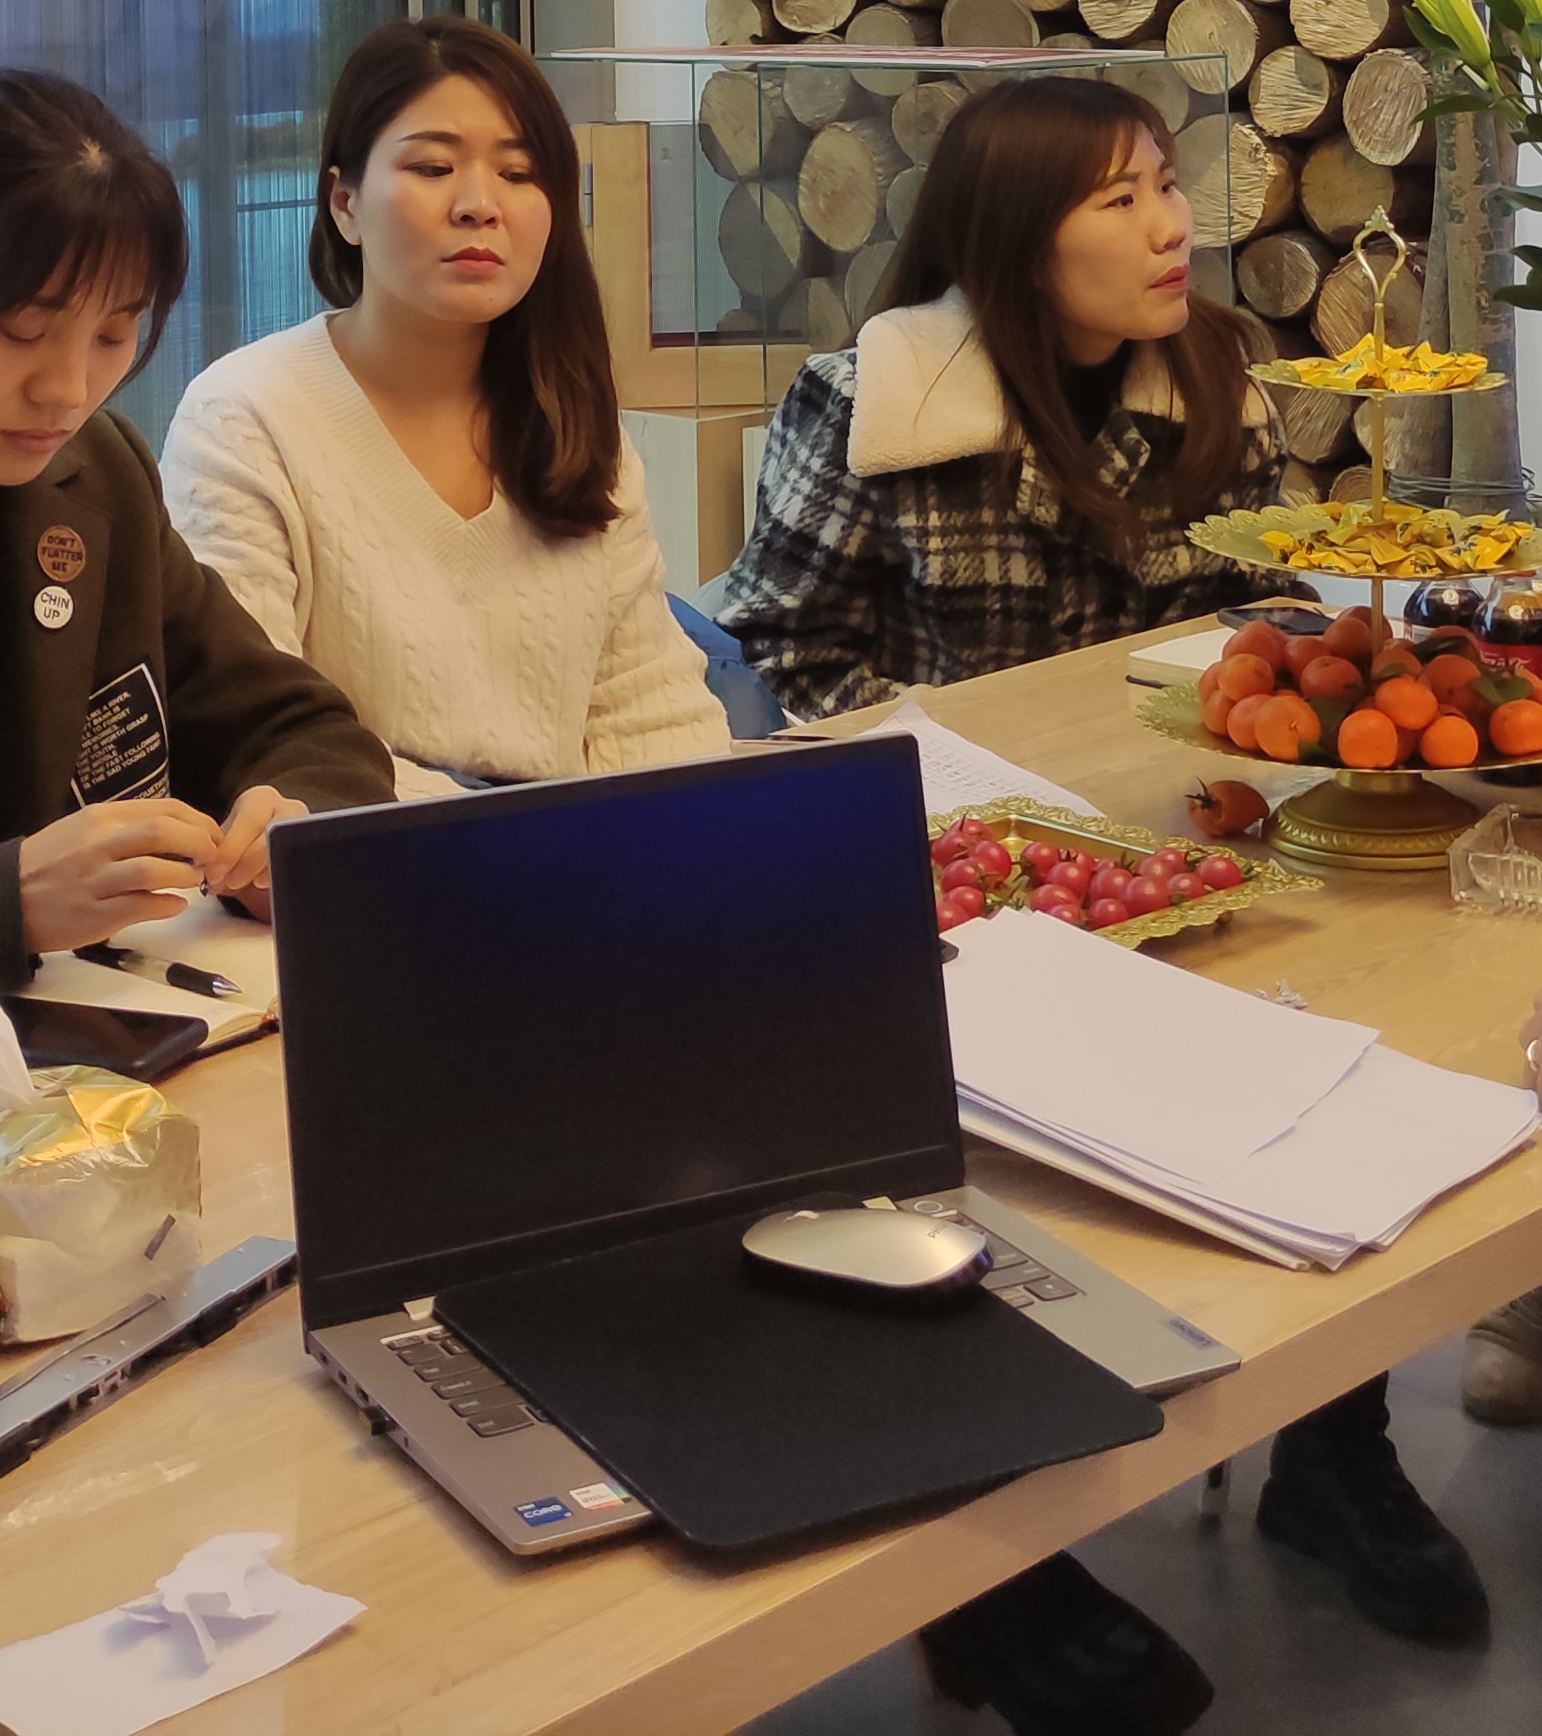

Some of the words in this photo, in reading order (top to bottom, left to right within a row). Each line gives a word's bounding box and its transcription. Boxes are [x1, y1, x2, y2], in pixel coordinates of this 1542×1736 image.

[47, 535, 76, 548] DON'T
[42, 547, 83, 562] FLATTER
[41, 592, 69, 610] CHIN
[43, 608, 60, 620] UP
